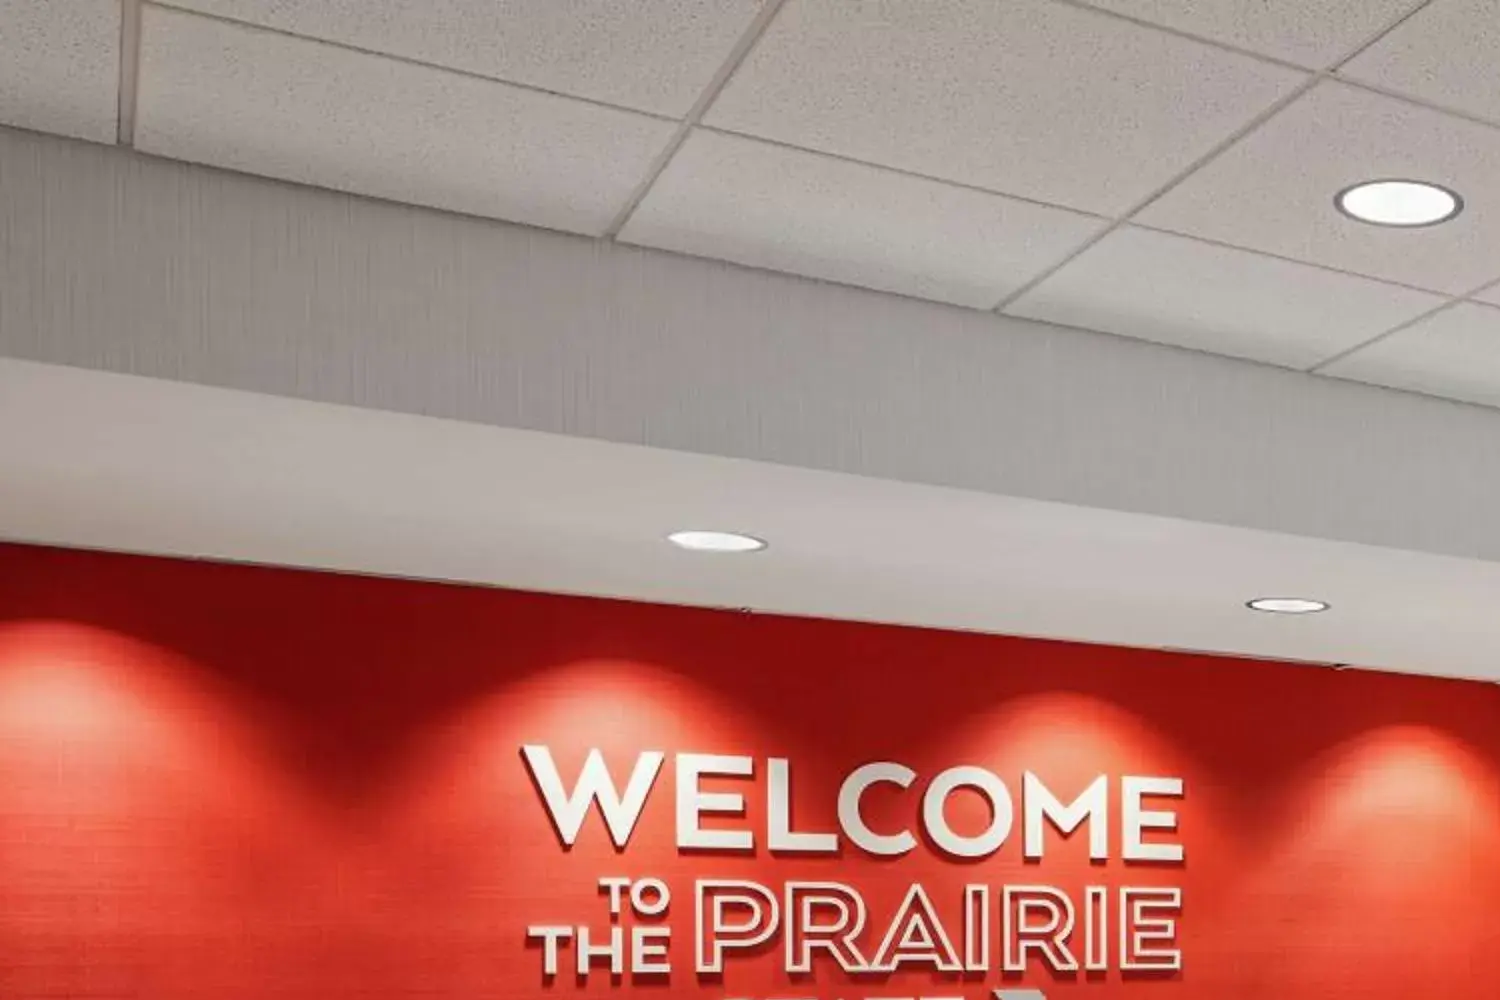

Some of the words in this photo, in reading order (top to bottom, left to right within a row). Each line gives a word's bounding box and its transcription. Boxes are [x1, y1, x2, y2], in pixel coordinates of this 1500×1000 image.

[520, 744, 1185, 861] WELCOME
[527, 925, 671, 975] THE
[694, 878, 1183, 974] PRAIRIE
[600, 877, 671, 915] TO
